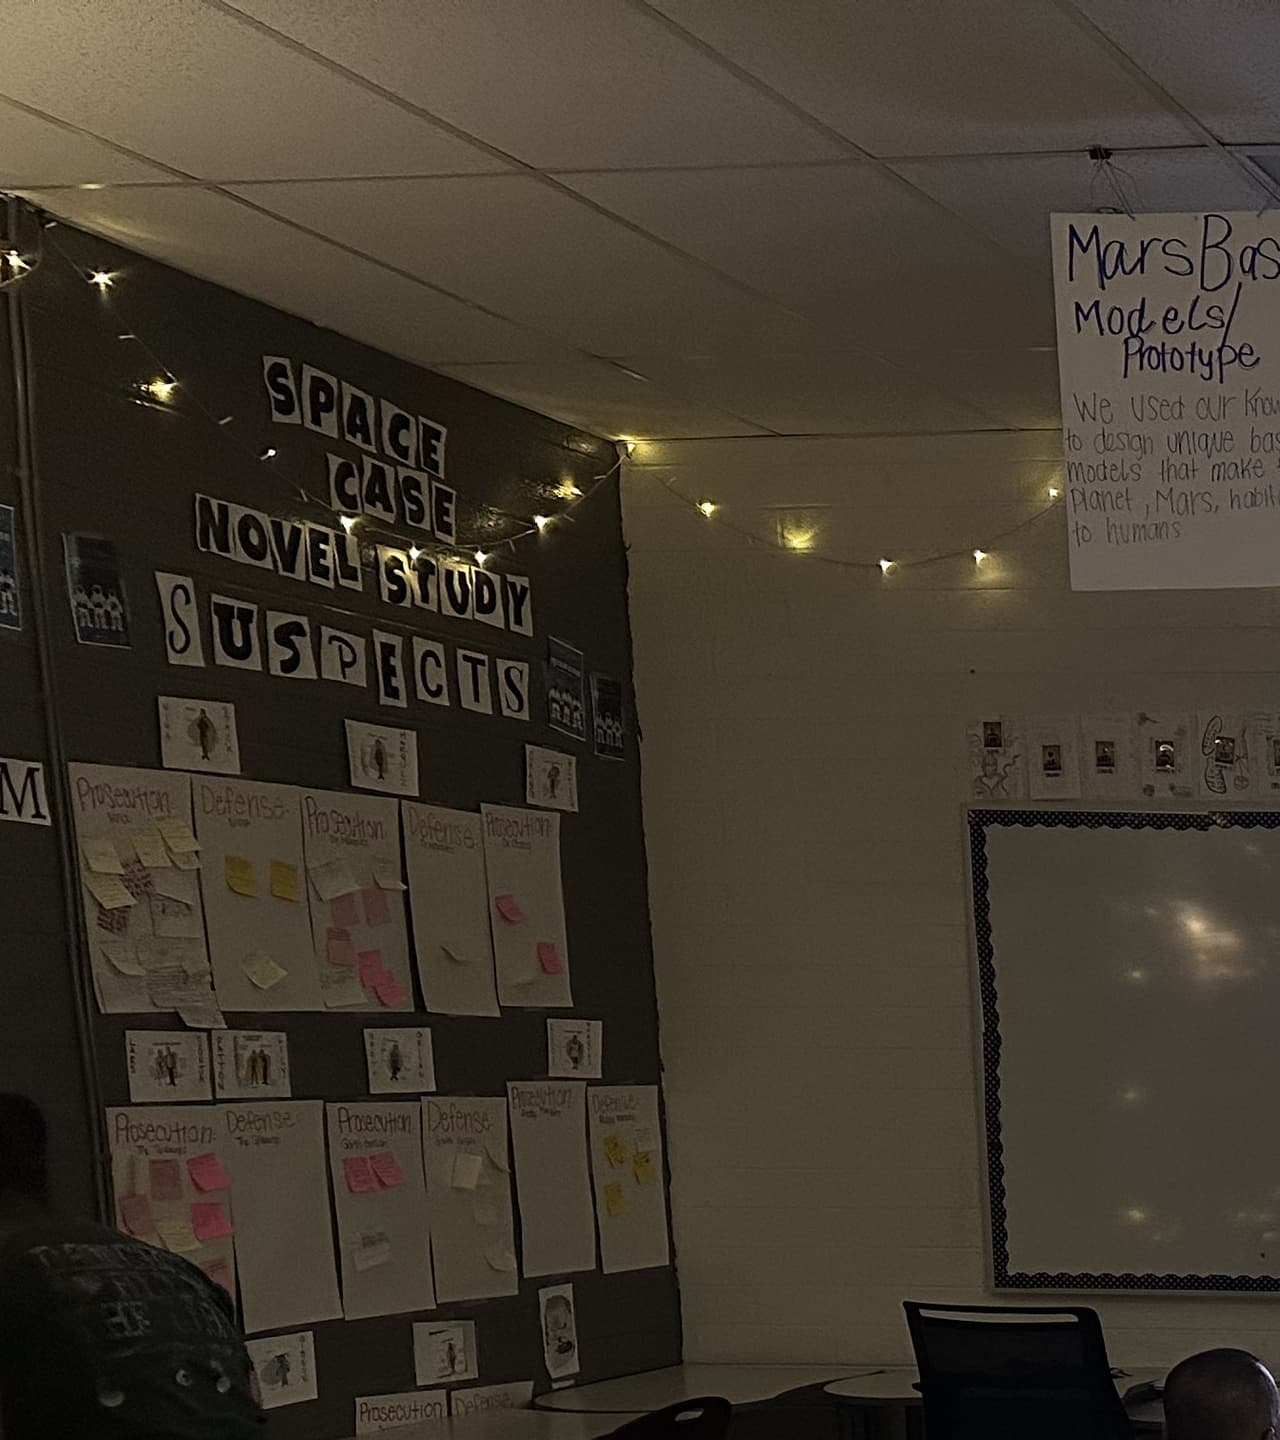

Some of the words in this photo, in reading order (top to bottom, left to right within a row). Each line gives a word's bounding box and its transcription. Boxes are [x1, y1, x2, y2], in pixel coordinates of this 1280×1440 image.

[1069, 223, 1195, 290] Mars
[1123, 335, 1260, 384] Prototype
[263, 355, 448, 478] SPACE
[1073, 392, 1113, 425] We
[1196, 396, 1236, 420] our
[1065, 428, 1083, 451] to
[1093, 427, 1154, 460] design
[1167, 430, 1234, 459] unique
[330, 457, 456, 542] CASE
[199, 496, 362, 586] NOVEL
[381, 550, 531, 633] STUDY
[166, 581, 527, 714] SUSPECTS
[360, 1402, 443, 1423] Prosecution
